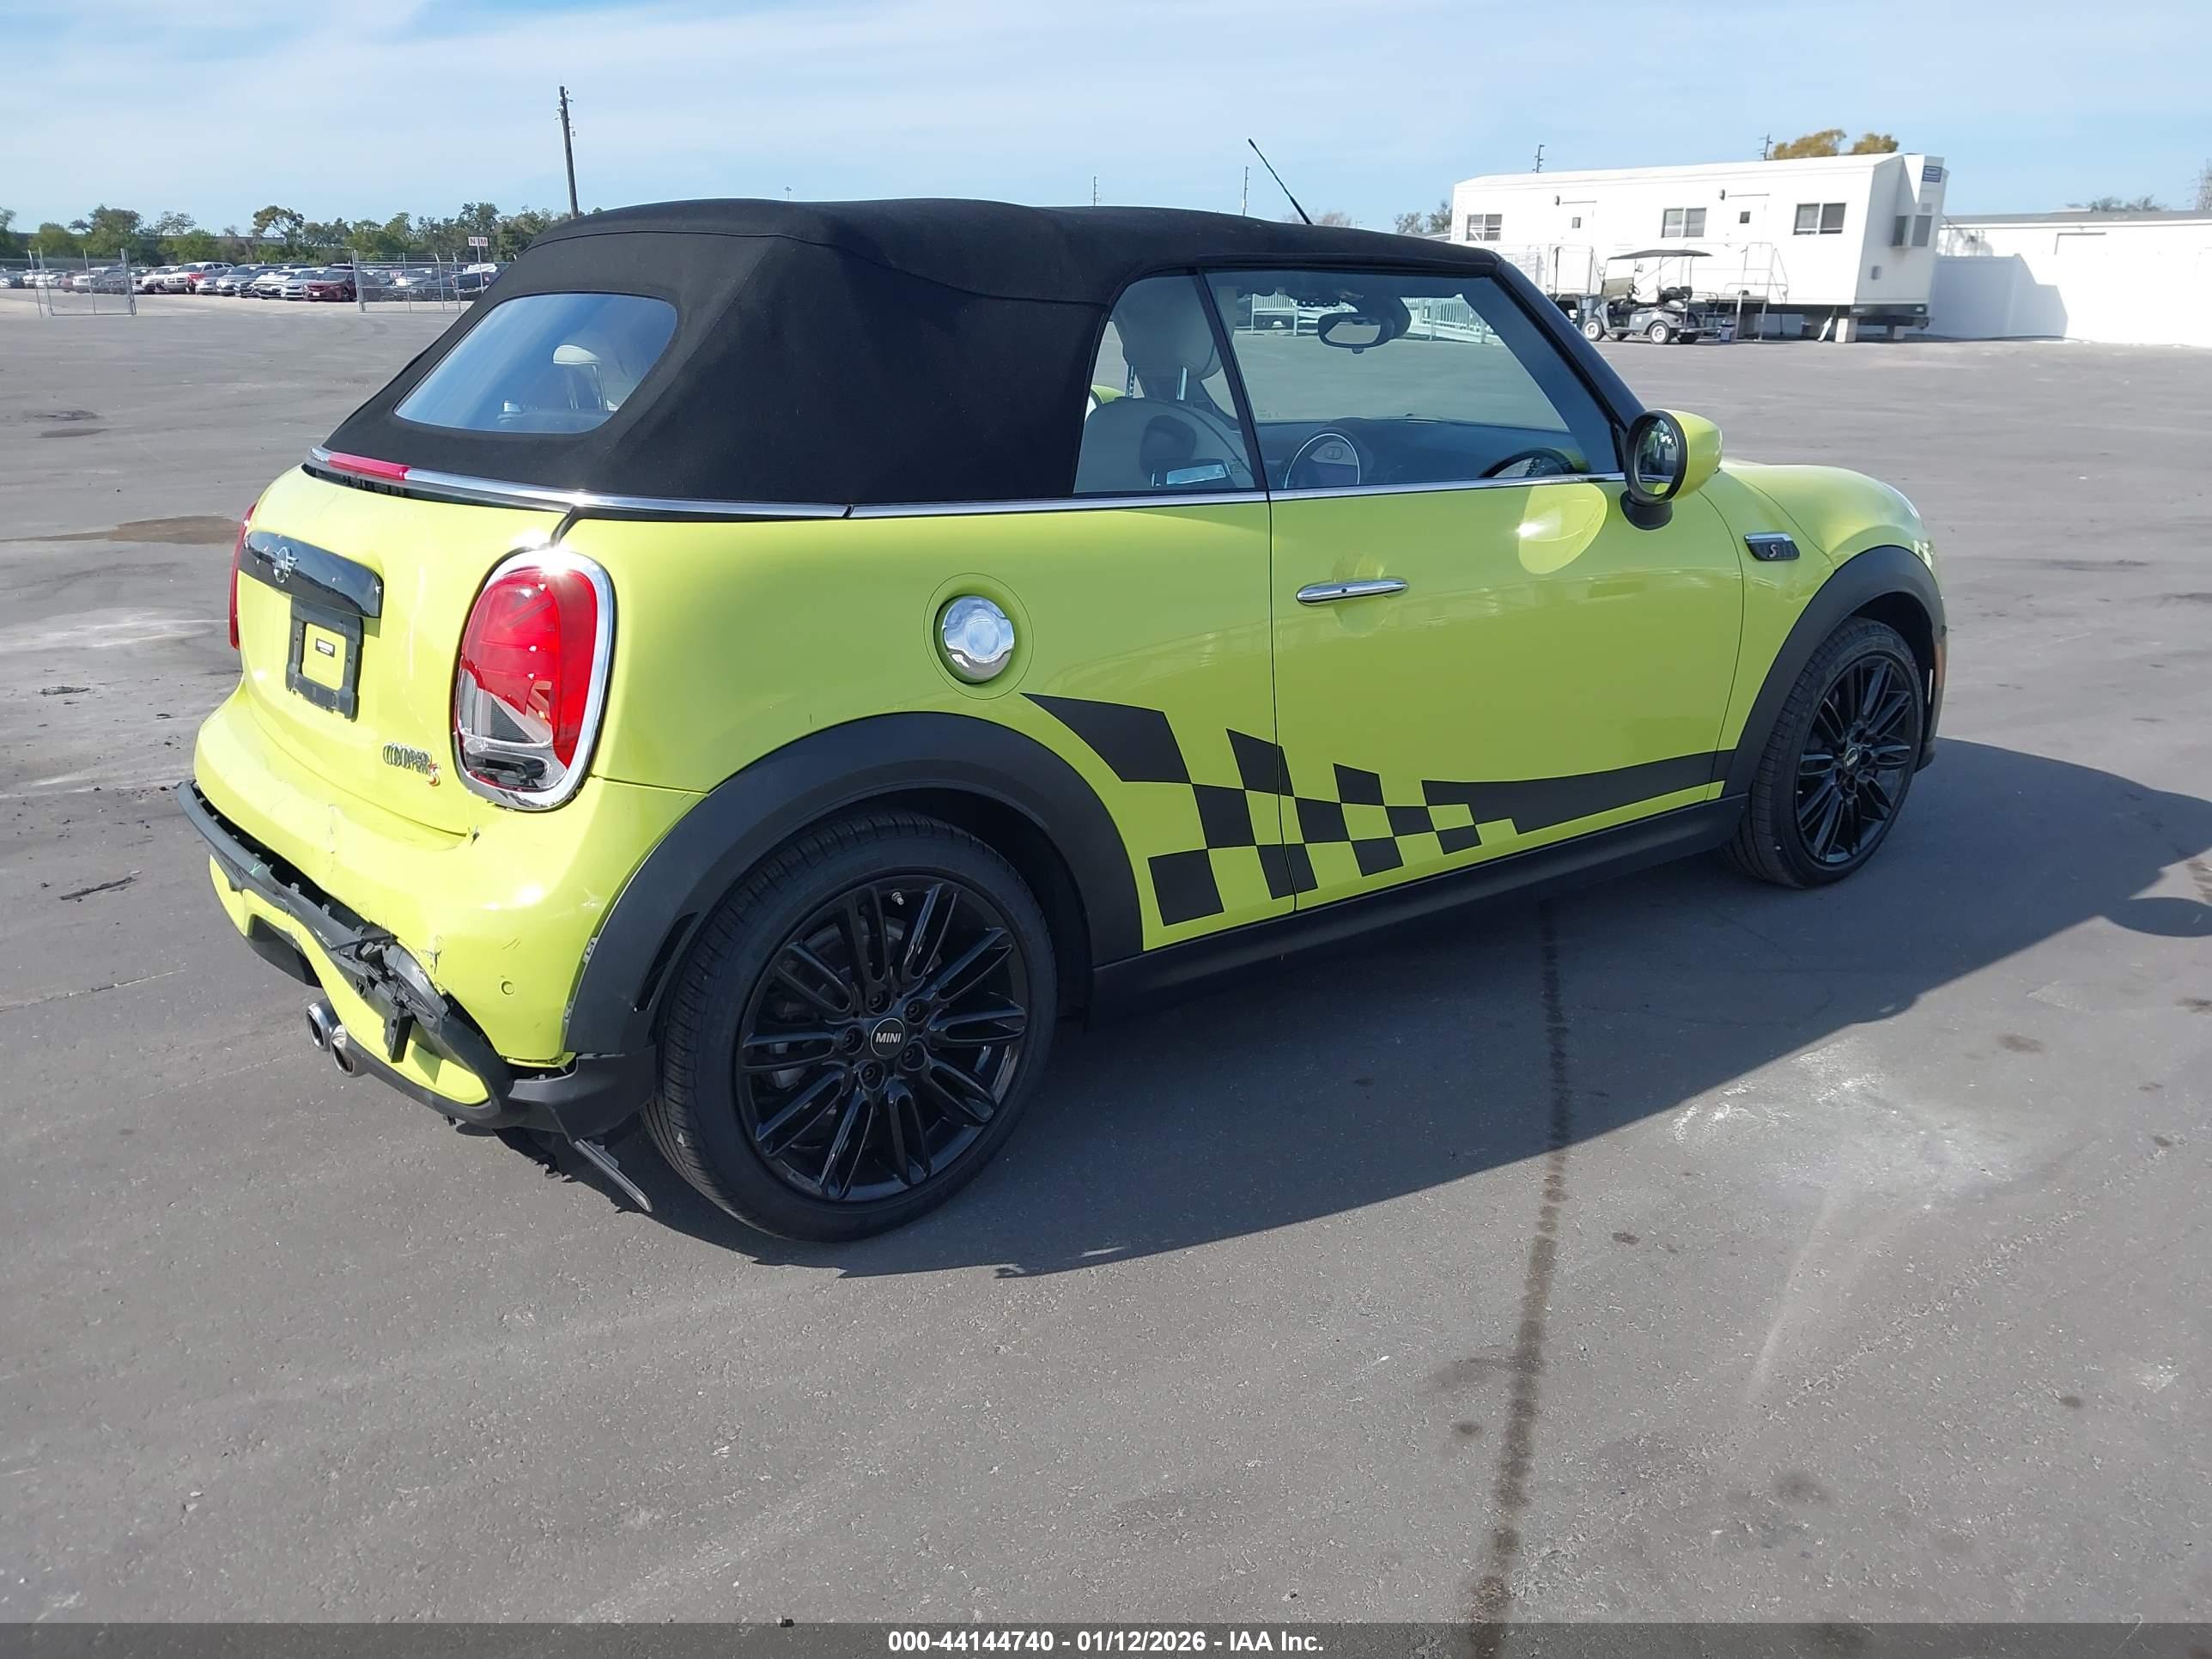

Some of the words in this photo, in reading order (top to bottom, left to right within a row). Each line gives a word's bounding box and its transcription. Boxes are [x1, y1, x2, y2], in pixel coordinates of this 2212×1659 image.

[1769, 544, 1778, 558] S
[382, 744, 431, 776] COOPER
[427, 763, 441, 787] S
[875, 1032, 902, 1044] MINI
